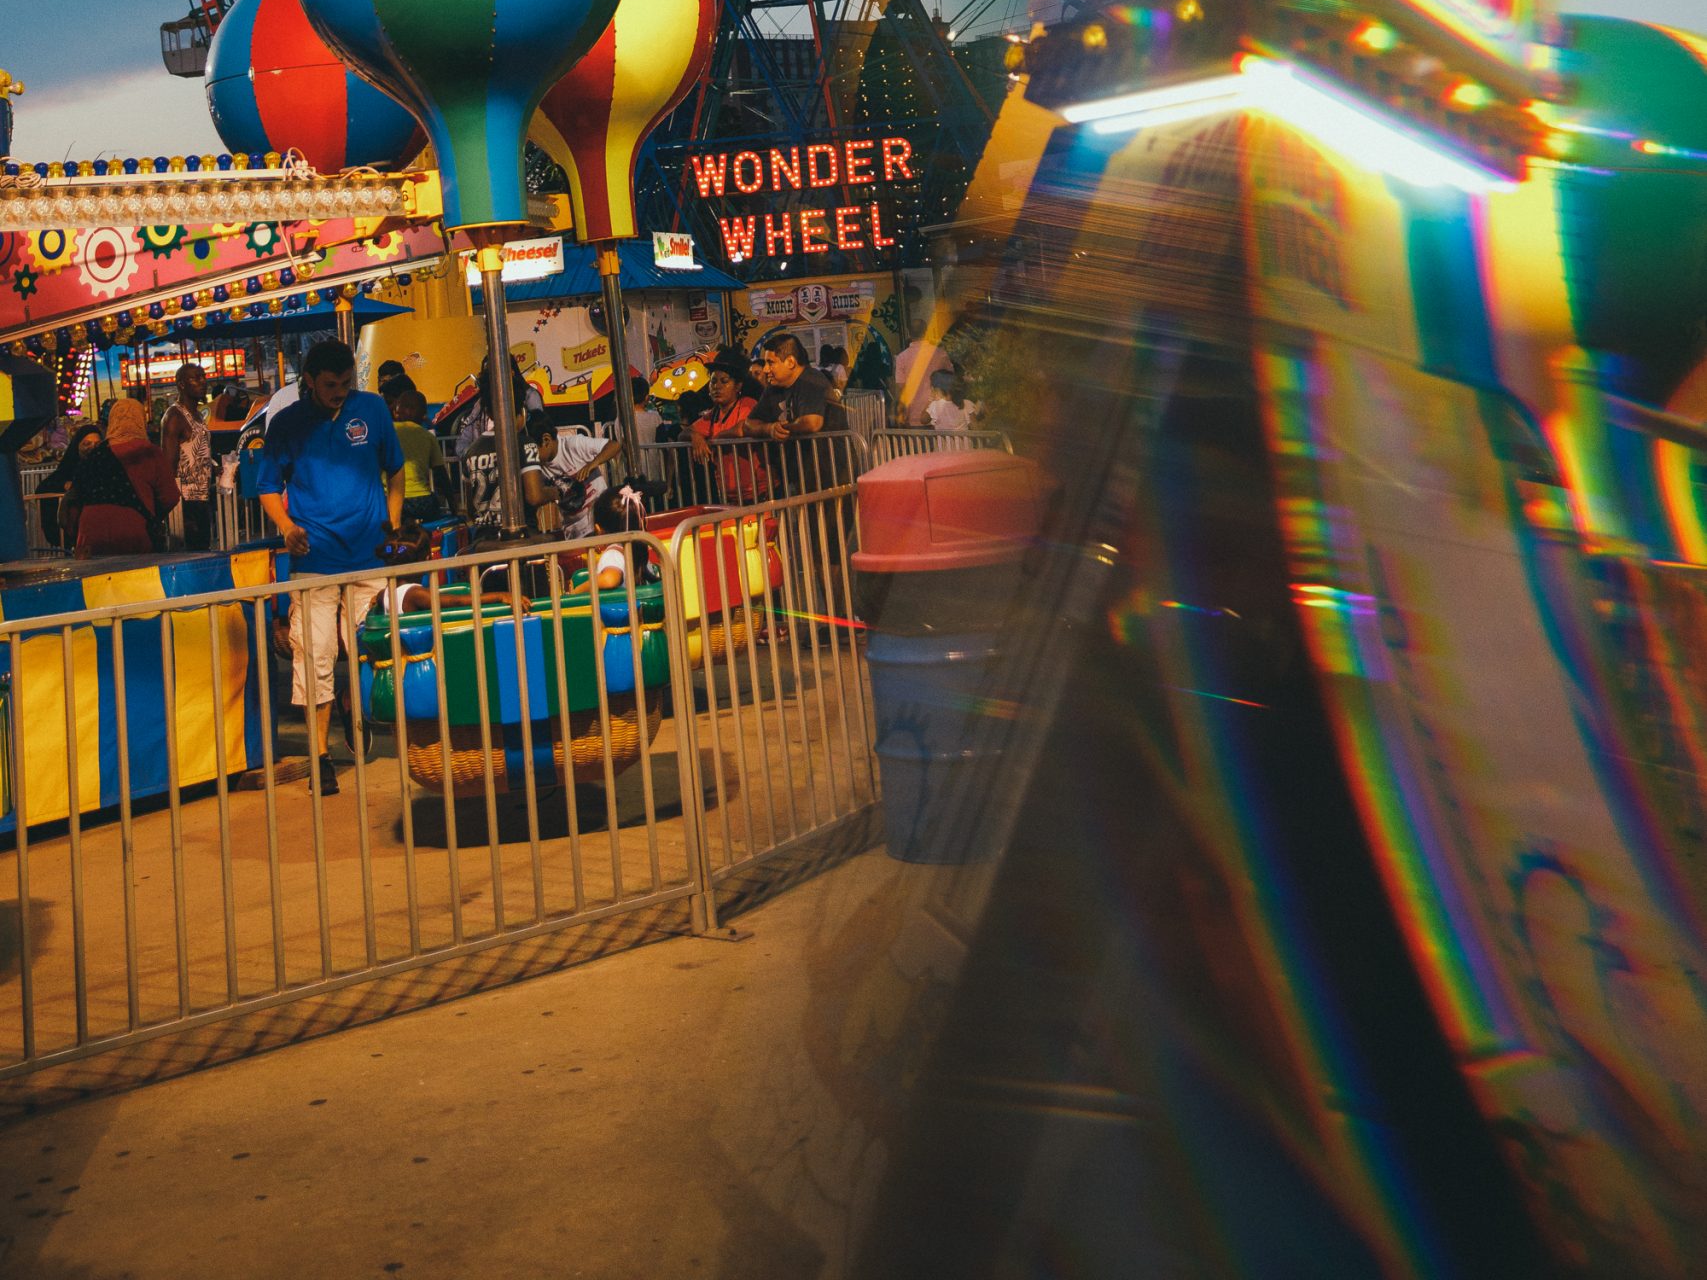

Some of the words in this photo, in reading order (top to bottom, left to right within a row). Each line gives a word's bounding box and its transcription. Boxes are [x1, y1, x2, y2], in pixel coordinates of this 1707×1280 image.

[691, 137, 913, 197] WONDER
[720, 204, 894, 260] WHEEL
[505, 242, 559, 262] heese!
[766, 299, 794, 315] MORE
[832, 294, 861, 310] RIDES
[573, 344, 607, 364] Tickets
